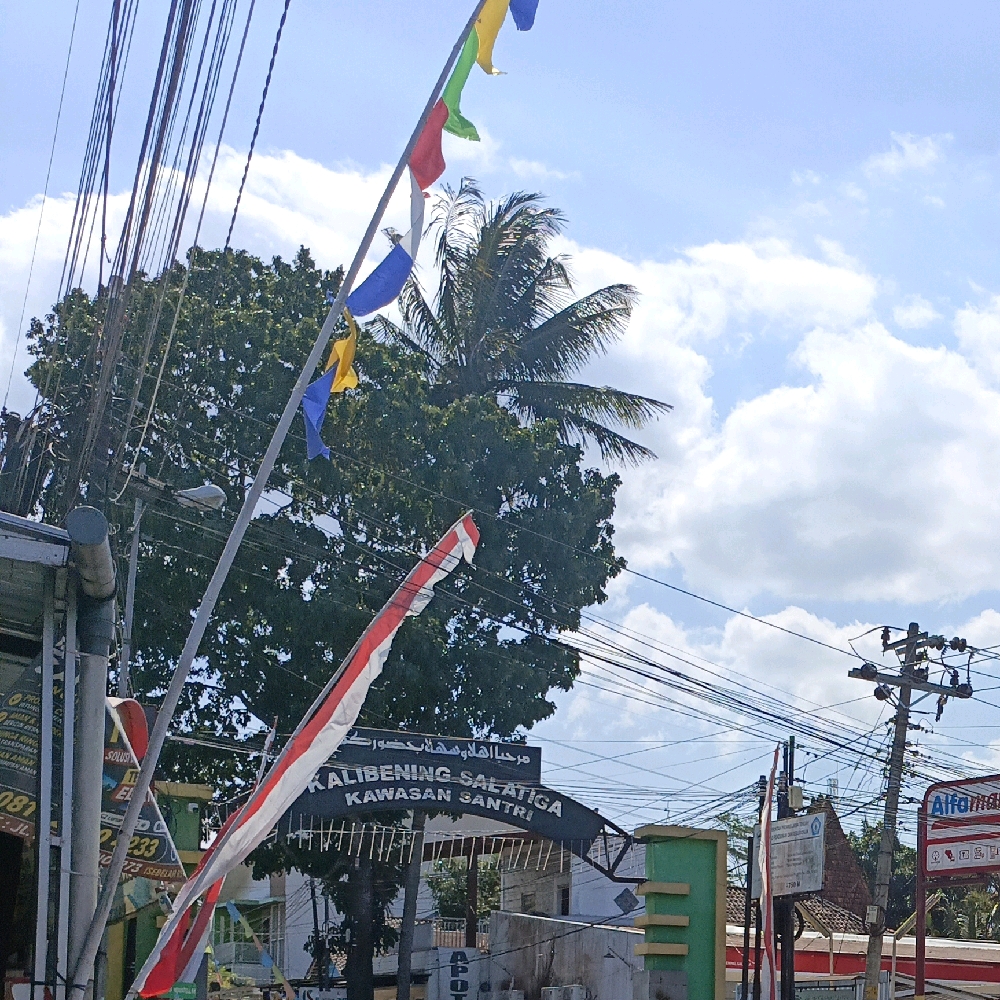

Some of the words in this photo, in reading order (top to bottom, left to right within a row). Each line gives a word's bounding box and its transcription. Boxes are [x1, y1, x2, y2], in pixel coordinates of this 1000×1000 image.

[308, 763, 451, 794] KALIBENING
[458, 769, 564, 818] SALATIGA
[345, 786, 452, 807] KAWASAN
[458, 790, 535, 822] SANTRI
